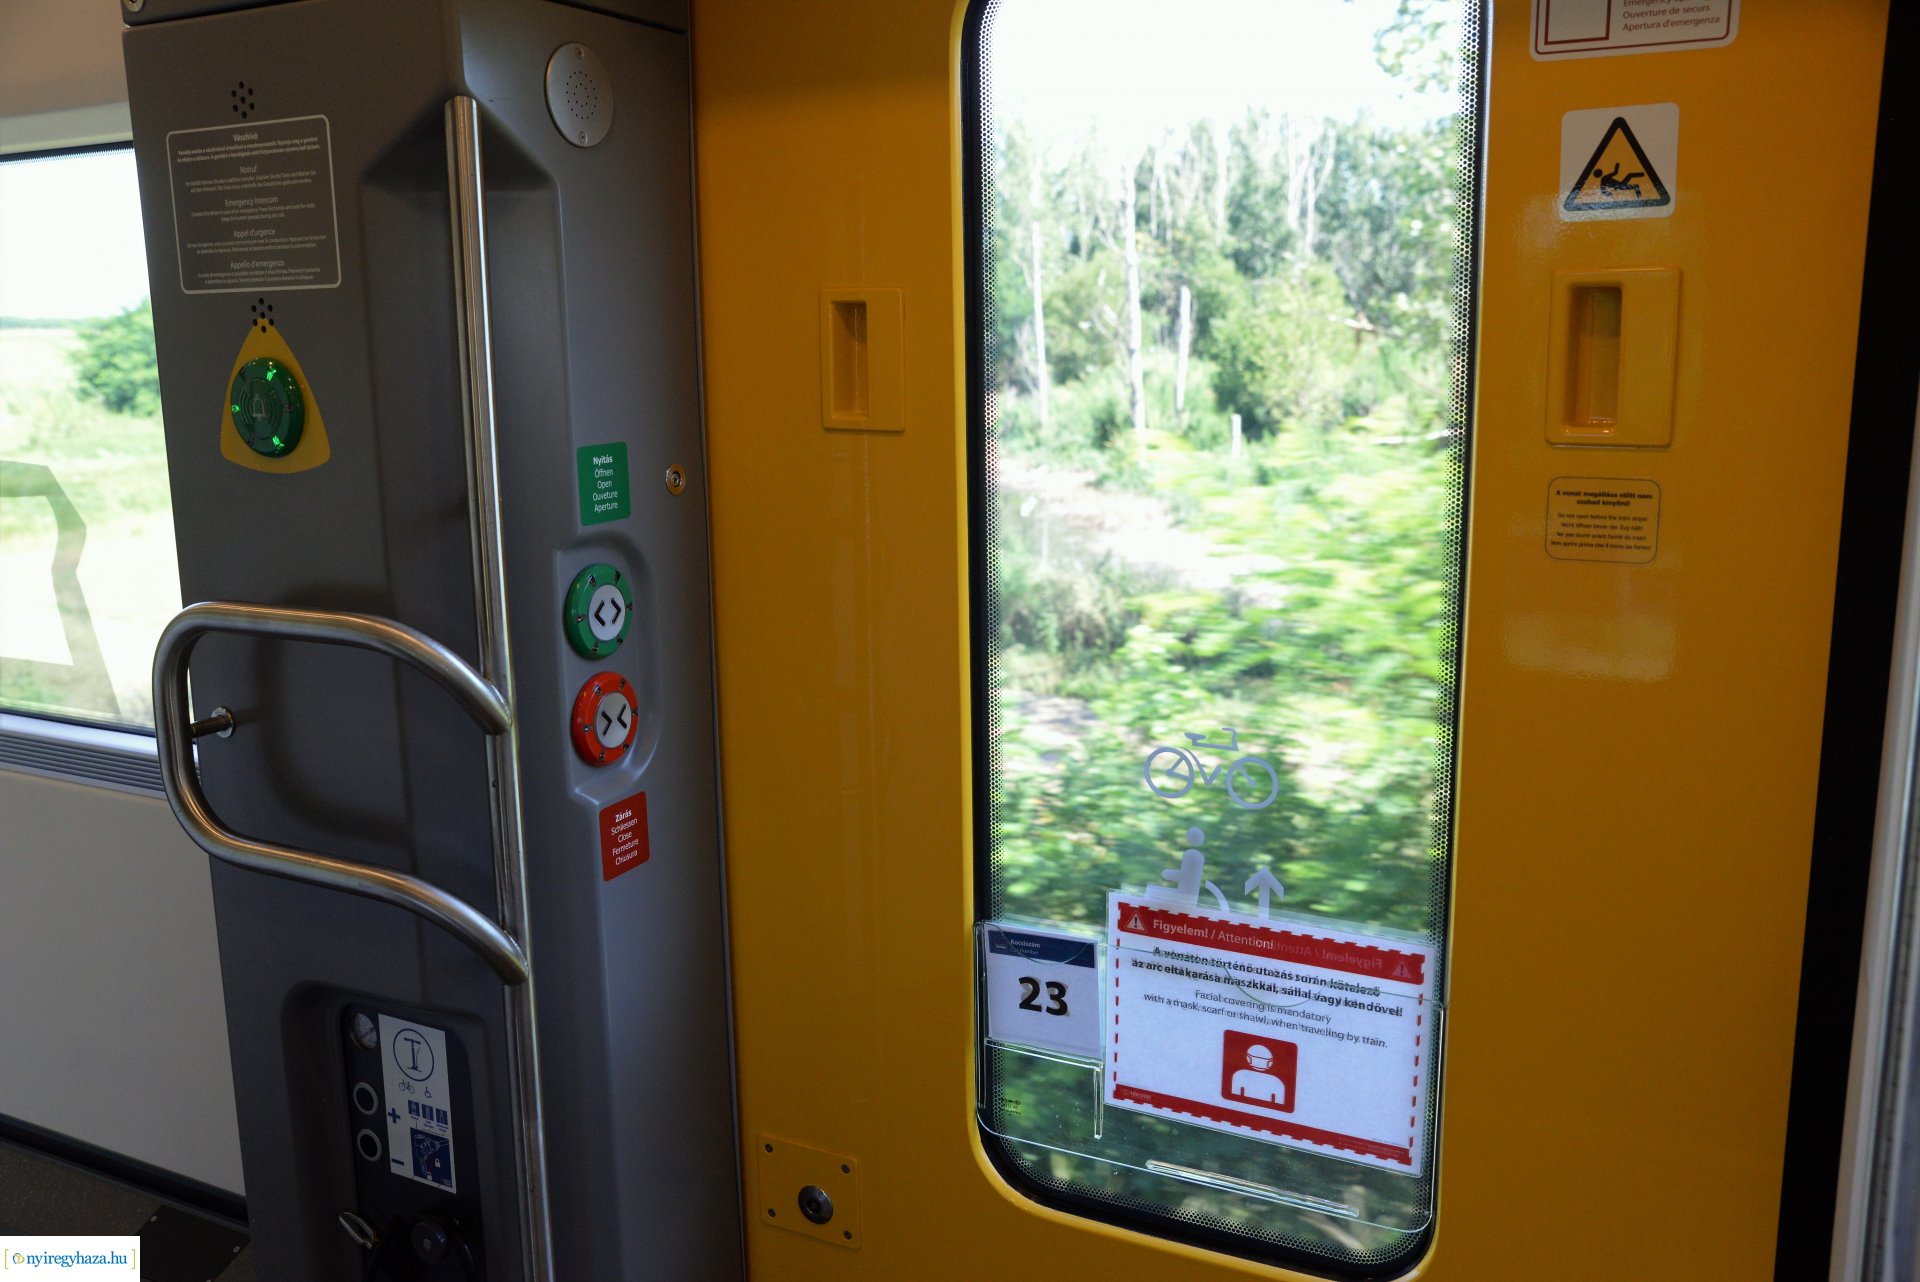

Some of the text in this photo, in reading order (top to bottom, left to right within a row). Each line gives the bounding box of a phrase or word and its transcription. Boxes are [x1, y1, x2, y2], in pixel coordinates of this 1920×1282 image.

[1623, 9, 1667, 19] Ouverture
[1668, 7, 1680, 15] de
[1622, 16, 1720, 32] Apertura d'emergenza
[240, 166, 257, 174] Notruf
[225, 198, 254, 208] Emergency
[233, 228, 276, 239] Appel d'urgence
[230, 260, 250, 270] Appello
[592, 454, 613, 466] Nyitás
[594, 468, 614, 478] Öffnen
[597, 480, 612, 490] Open
[615, 809, 632, 823] Zárás
[617, 831, 632, 843] Close
[612, 838, 639, 857] Fermeture
[1152, 919, 1274, 950] Figyelem! / Attention!
[1153, 946, 1381, 997] A vonaton történő utazás során kötelező
[1132, 959, 1403, 1017] az arc eltakarása maszkkal, sállal vagy kendővel!
[1018, 976, 1069, 1016] 23
[1195, 989, 1332, 1025] Facial covering is mandatory
[1143, 993, 1164, 1004] with
[1173, 998, 1200, 1012] mask,
[1202, 1003, 1224, 1015] scarf
[1226, 1009, 1237, 1017] or
[1271, 1018, 1298, 1031] when
[1301, 1024, 1345, 1041] traveling
[1347, 1031, 1360, 1044] by
[1362, 1036, 1388, 1048] train.
